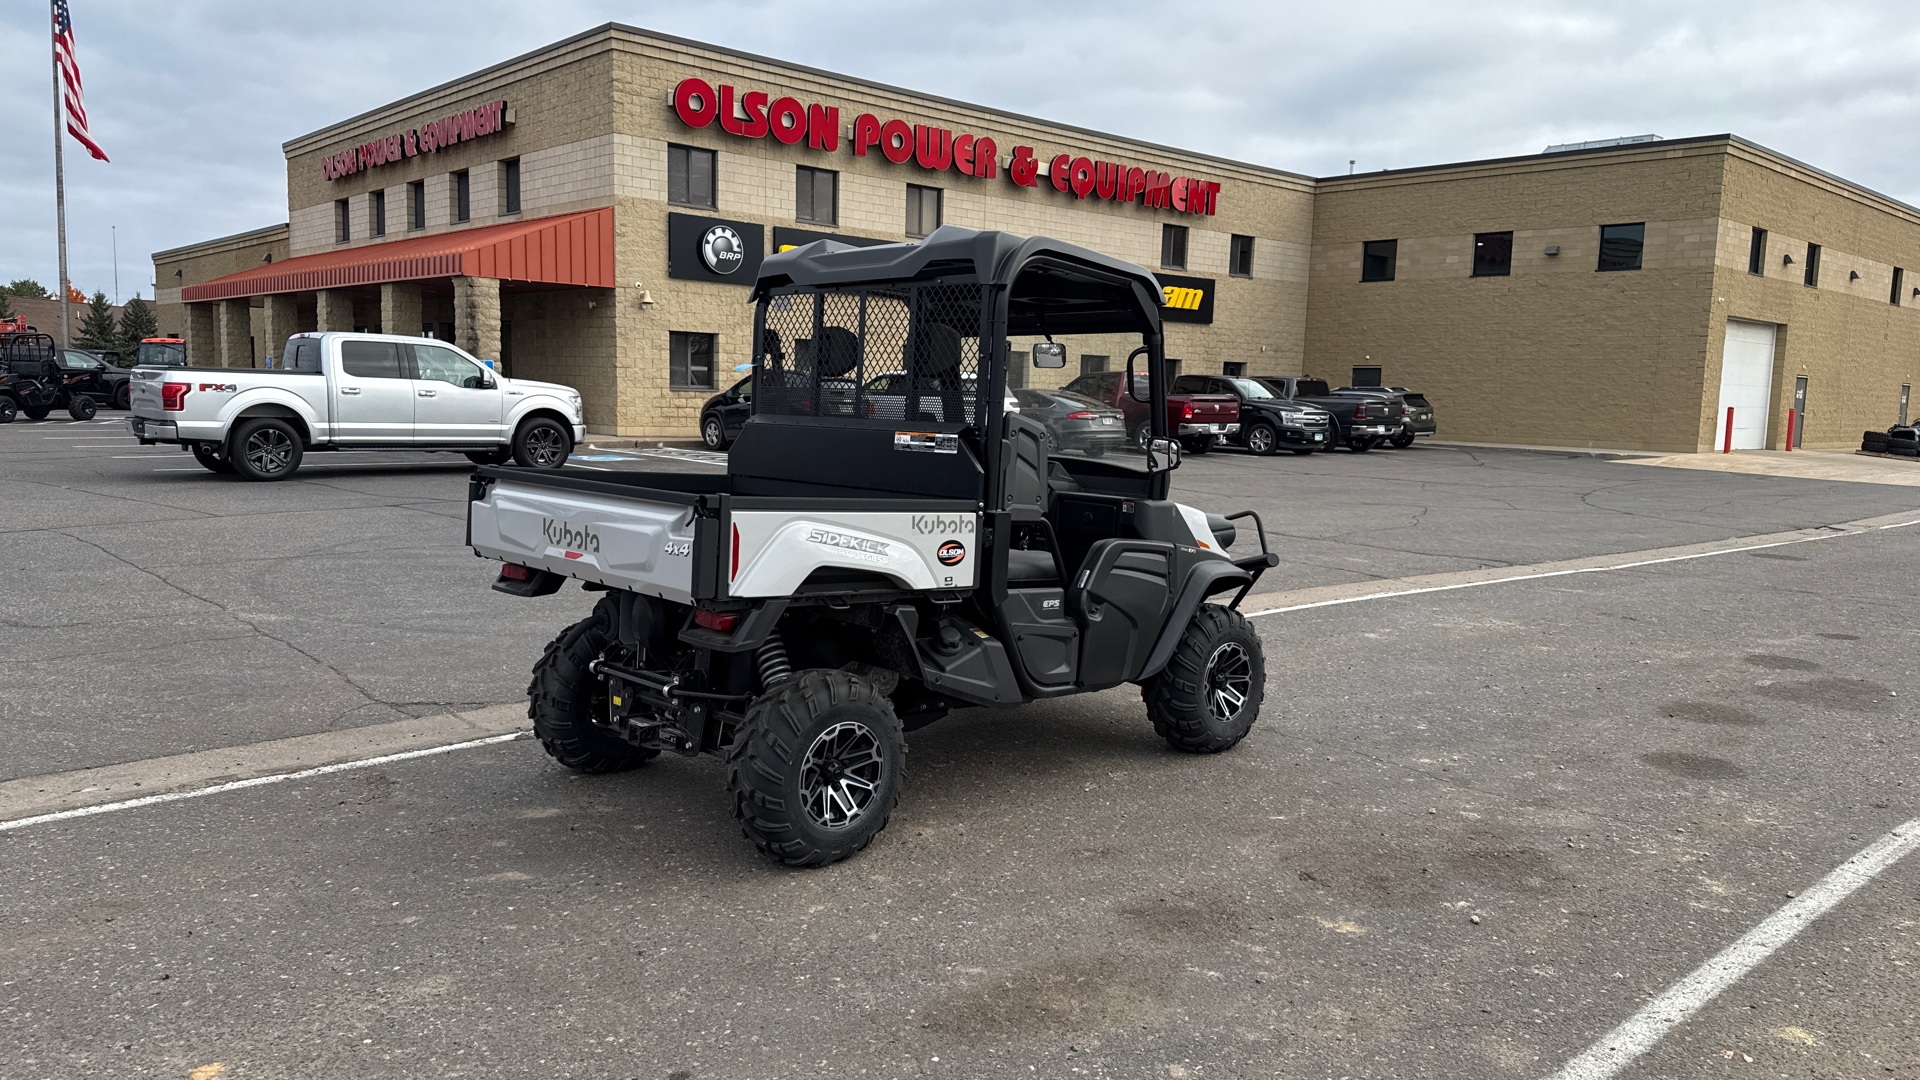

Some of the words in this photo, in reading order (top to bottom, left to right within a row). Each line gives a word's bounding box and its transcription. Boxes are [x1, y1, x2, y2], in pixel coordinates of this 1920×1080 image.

[321, 148, 357, 181] OLSON
[358, 133, 402, 171] POWER
[404, 129, 418, 158] &
[419, 100, 504, 154] EQUIPMENT
[674, 78, 840, 152] OLSON
[854, 113, 997, 179] POWER
[1010, 145, 1039, 188] &
[1050, 153, 1221, 216] EQUIPMENT
[719, 251, 742, 261] BRP
[199, 383, 237, 393] FX4
[912, 514, 975, 535] Kubota
[542, 517, 600, 554] Kubota
[806, 529, 890, 556] SIDEKICK
[664, 541, 690, 557] 4x4
[939, 548, 964, 556] OLSON
[1042, 599, 1060, 608] EPS
